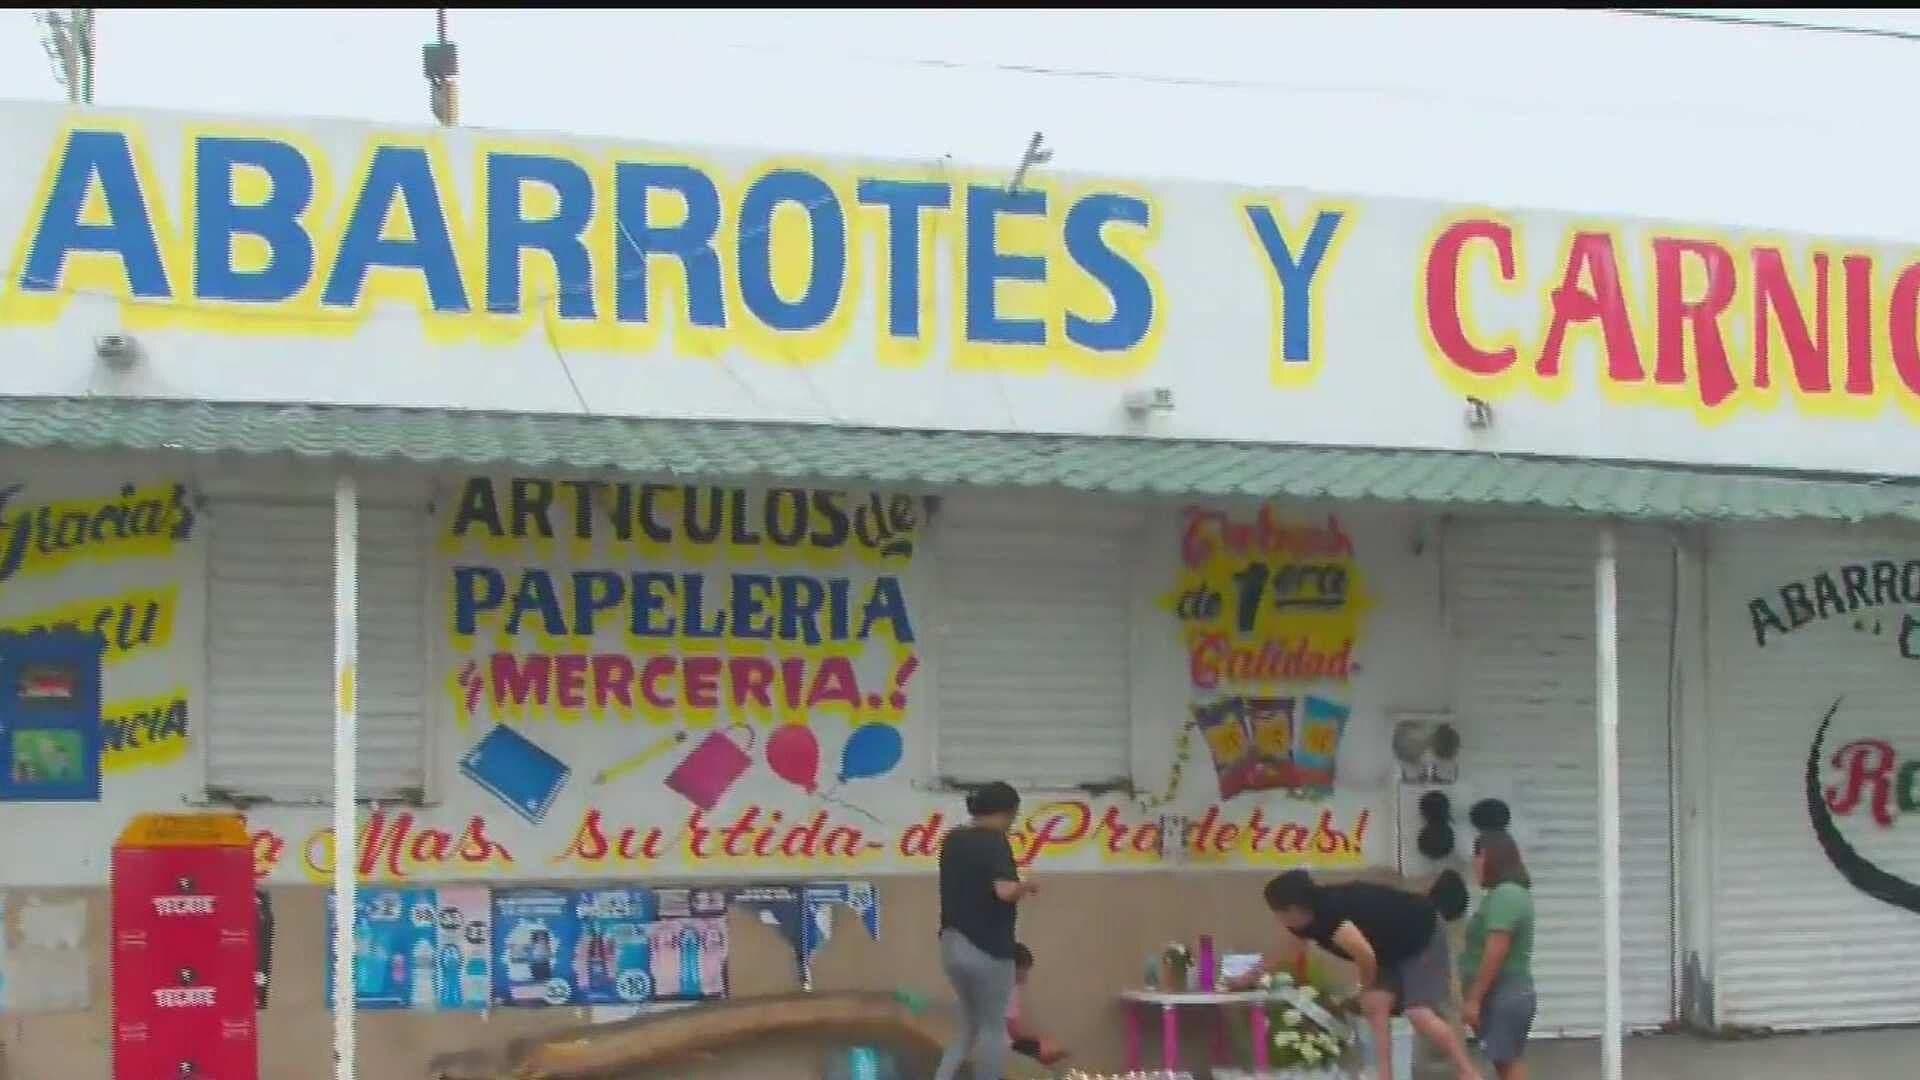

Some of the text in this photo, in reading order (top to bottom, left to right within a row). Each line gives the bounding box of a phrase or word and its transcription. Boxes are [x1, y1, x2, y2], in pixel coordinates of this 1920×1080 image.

[21, 130, 1154, 352] ABARROTES
[1246, 205, 1344, 363] Y
[453, 477, 848, 548] ARTICULOS
[455, 565, 915, 645] PAPELERIA
